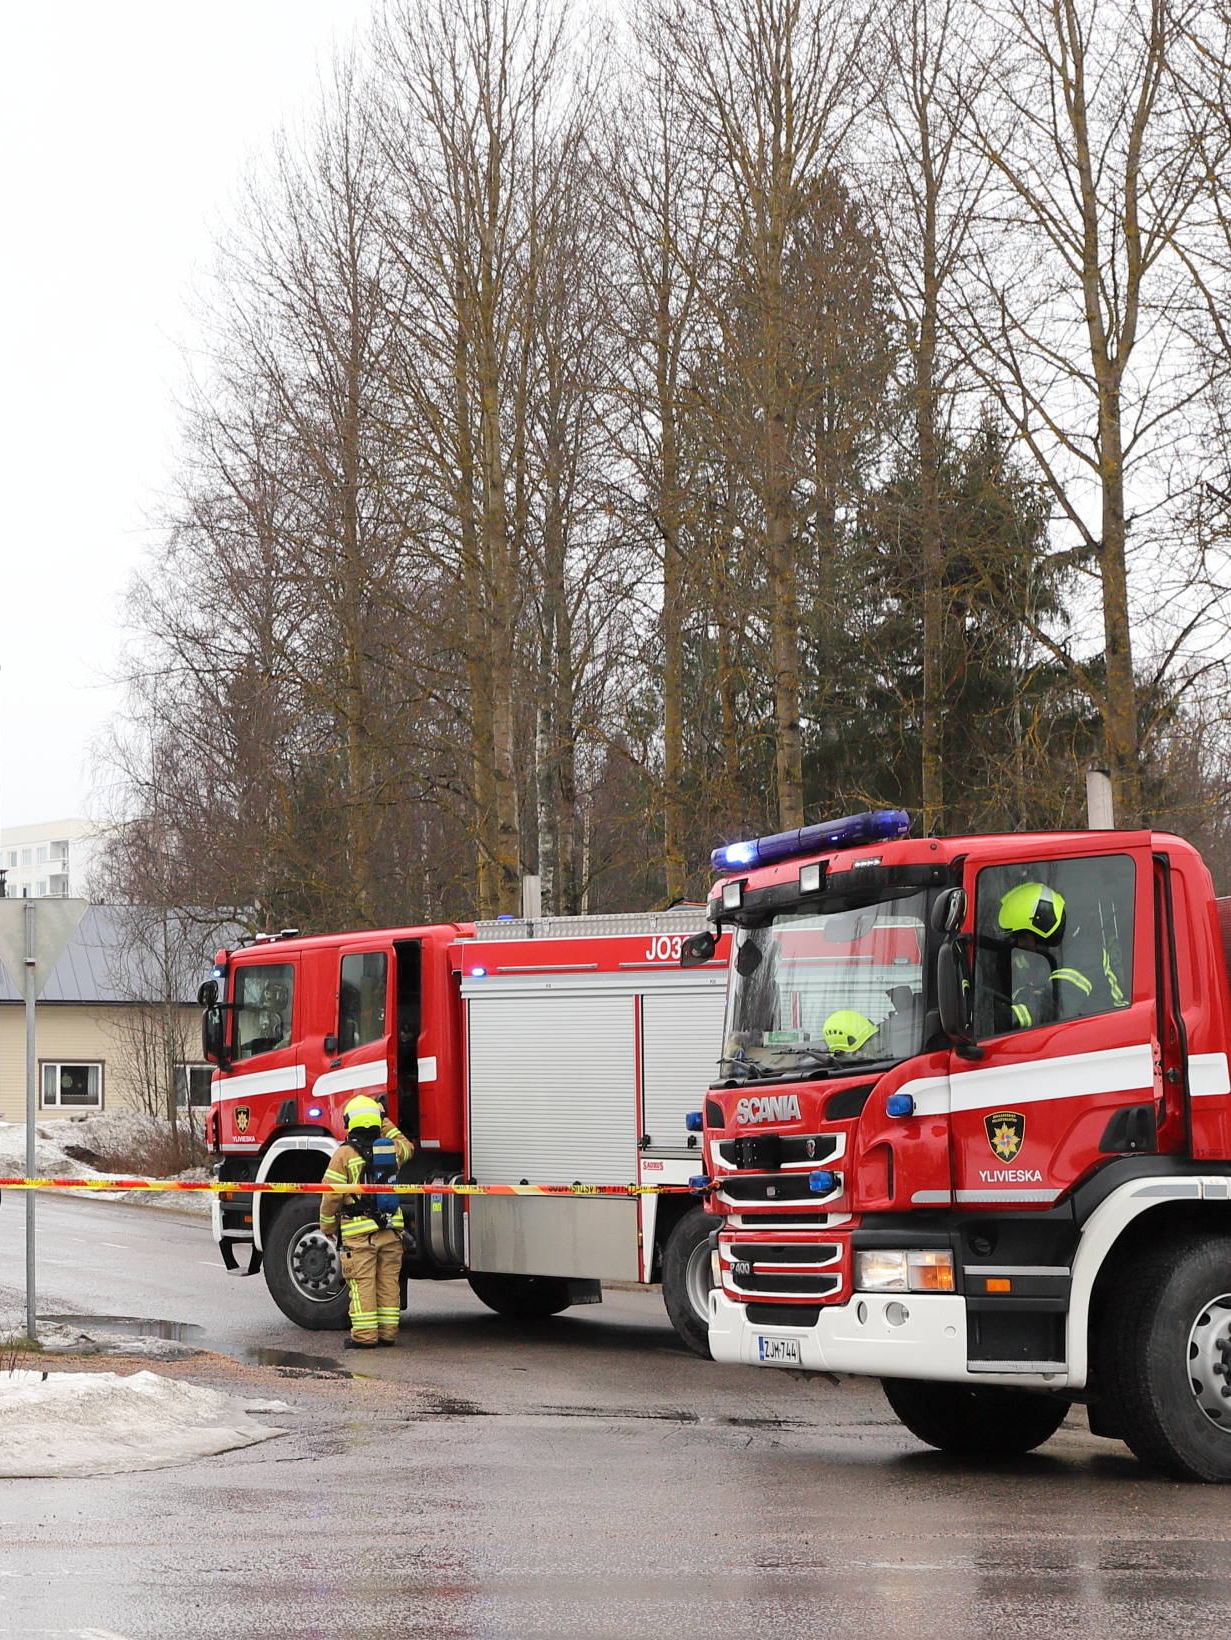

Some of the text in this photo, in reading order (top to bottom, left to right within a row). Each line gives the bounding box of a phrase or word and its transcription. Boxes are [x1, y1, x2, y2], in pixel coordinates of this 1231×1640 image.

[645, 936, 690, 960] JO3
[736, 1094, 803, 1125] SCANIA
[232, 1135, 256, 1143] YLIVIESKA
[978, 1169, 1043, 1183] YLIVIESKA
[764, 1340, 797, 1360] ZJM-744
